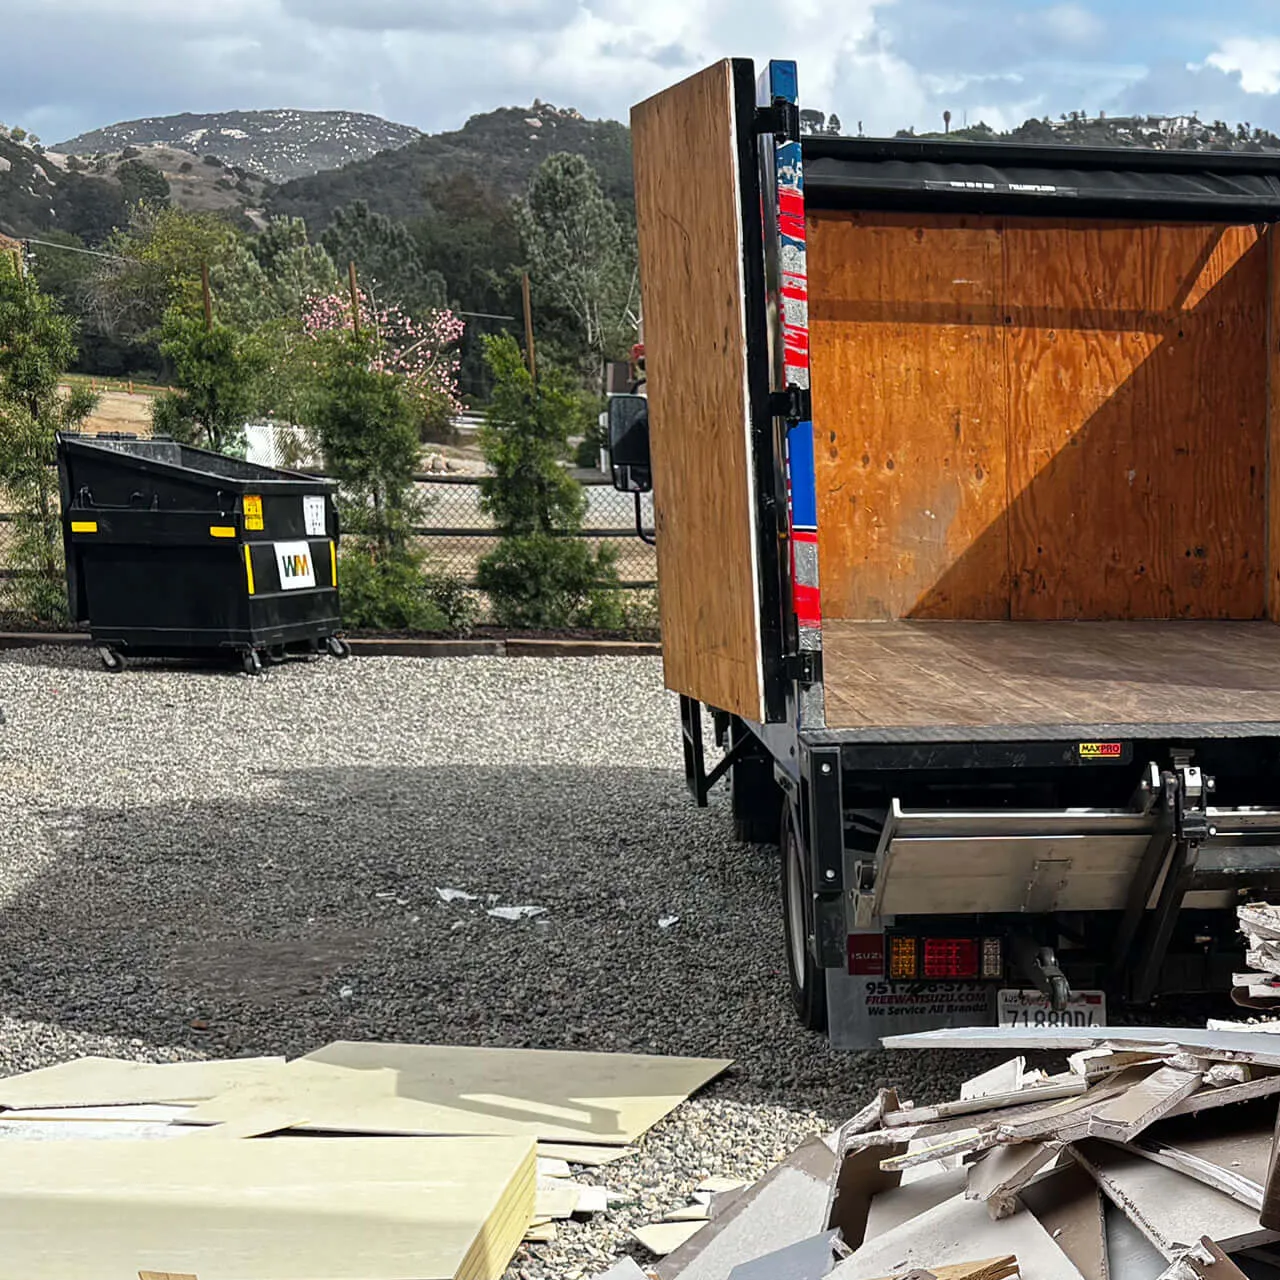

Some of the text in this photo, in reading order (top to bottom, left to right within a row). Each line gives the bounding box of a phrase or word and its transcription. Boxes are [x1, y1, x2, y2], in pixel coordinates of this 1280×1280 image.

[282, 554, 310, 577] WM
[1081, 744, 1120, 753] MAXPRO
[868, 1006, 883, 1017] We
[887, 1005, 926, 1016] Service
[928, 1004, 944, 1014] All
